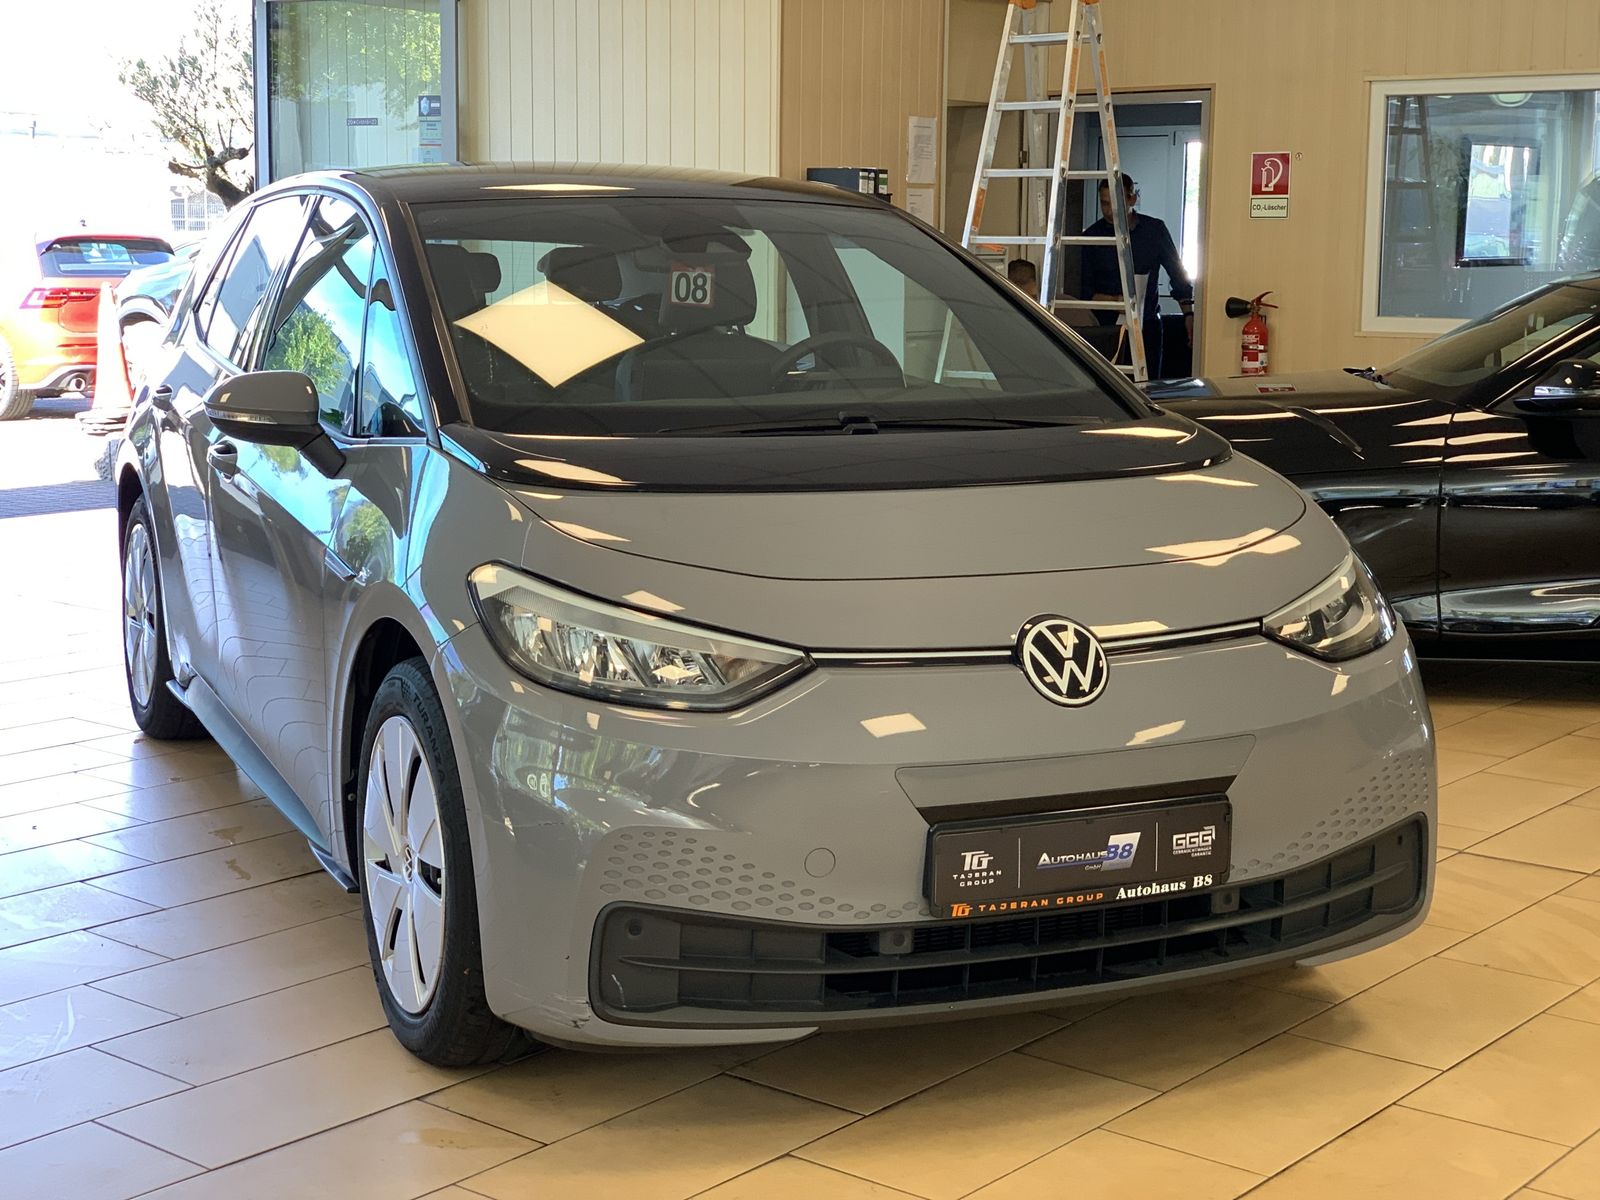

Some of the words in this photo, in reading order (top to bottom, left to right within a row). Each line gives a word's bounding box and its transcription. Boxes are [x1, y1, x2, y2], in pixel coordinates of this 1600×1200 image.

[674, 272, 708, 303] 08
[1025, 620, 1104, 700] VW
[1173, 829, 1213, 850] GGG
[961, 850, 994, 871] TG
[1105, 843, 1134, 861] B8
[952, 869, 1002, 880] TAJERAN
[959, 878, 994, 887] GROUP
[1116, 880, 1187, 900] Autohaus
[1192, 874, 1213, 888] B8
[951, 902, 973, 917] TG
[978, 899, 1049, 912] TAJERAN
[1056, 893, 1104, 905] GROUP
